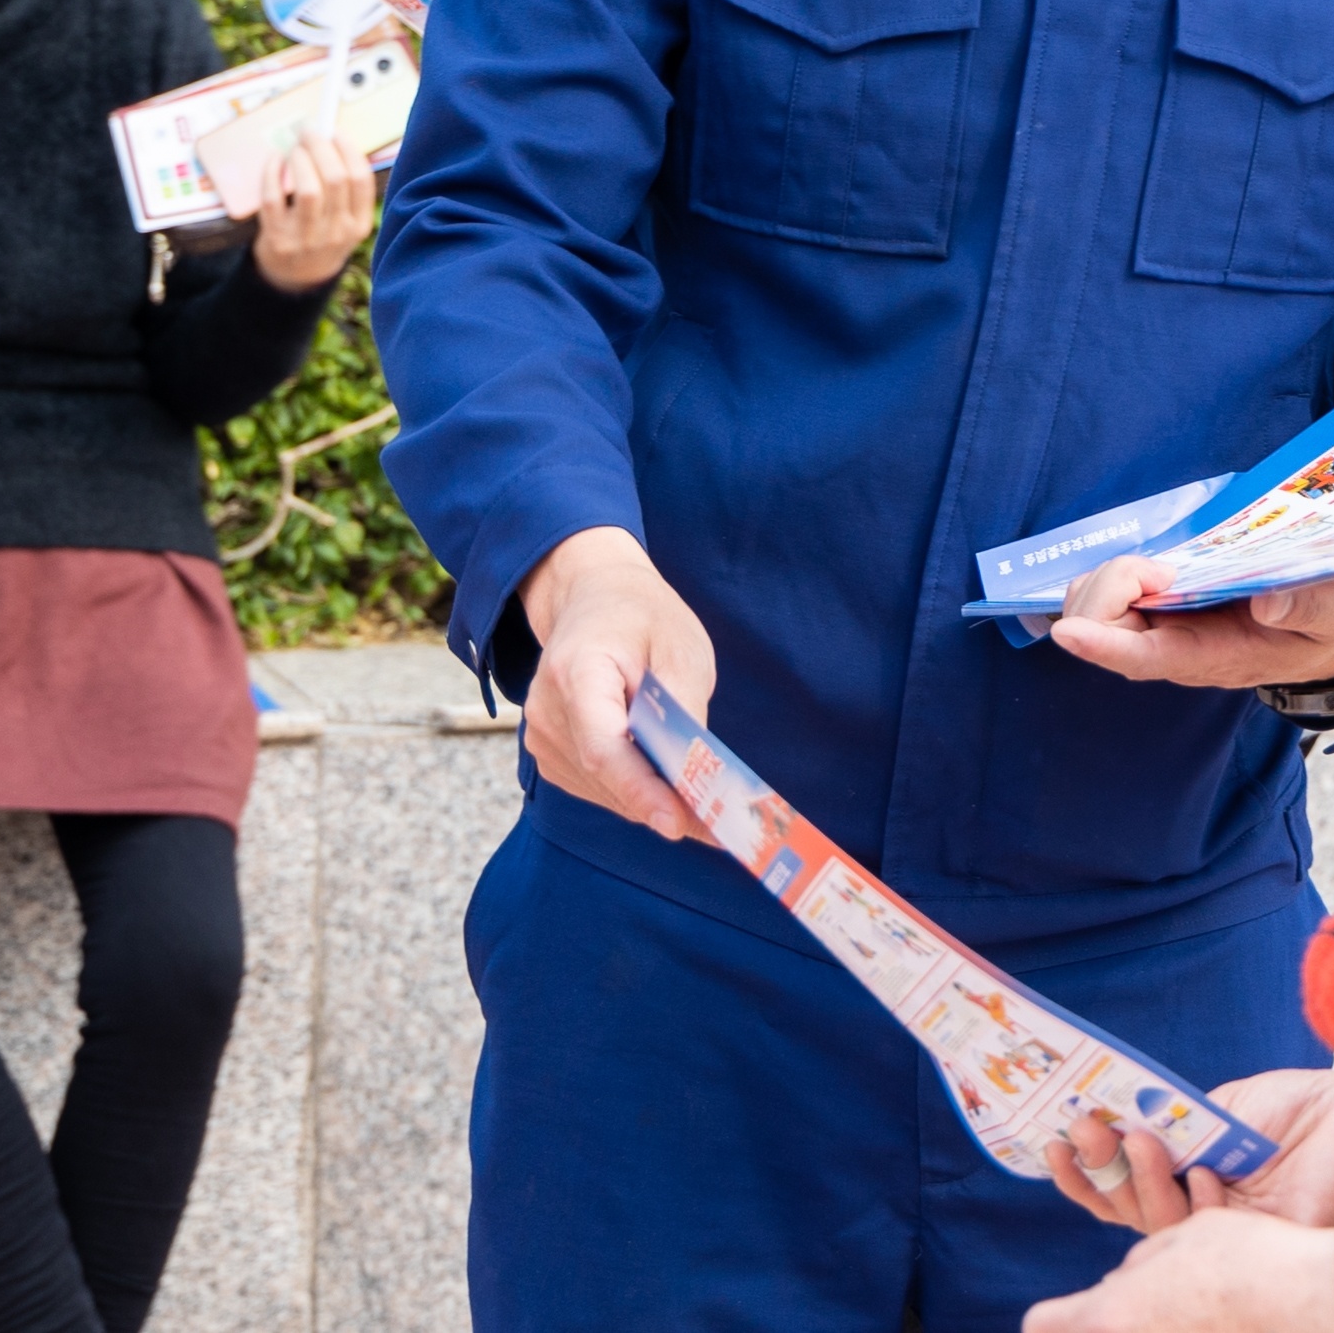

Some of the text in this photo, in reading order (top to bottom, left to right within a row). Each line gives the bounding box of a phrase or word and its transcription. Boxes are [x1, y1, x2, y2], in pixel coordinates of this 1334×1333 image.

[1023, 517, 1141, 567] 兴宁市消防安全委员会
